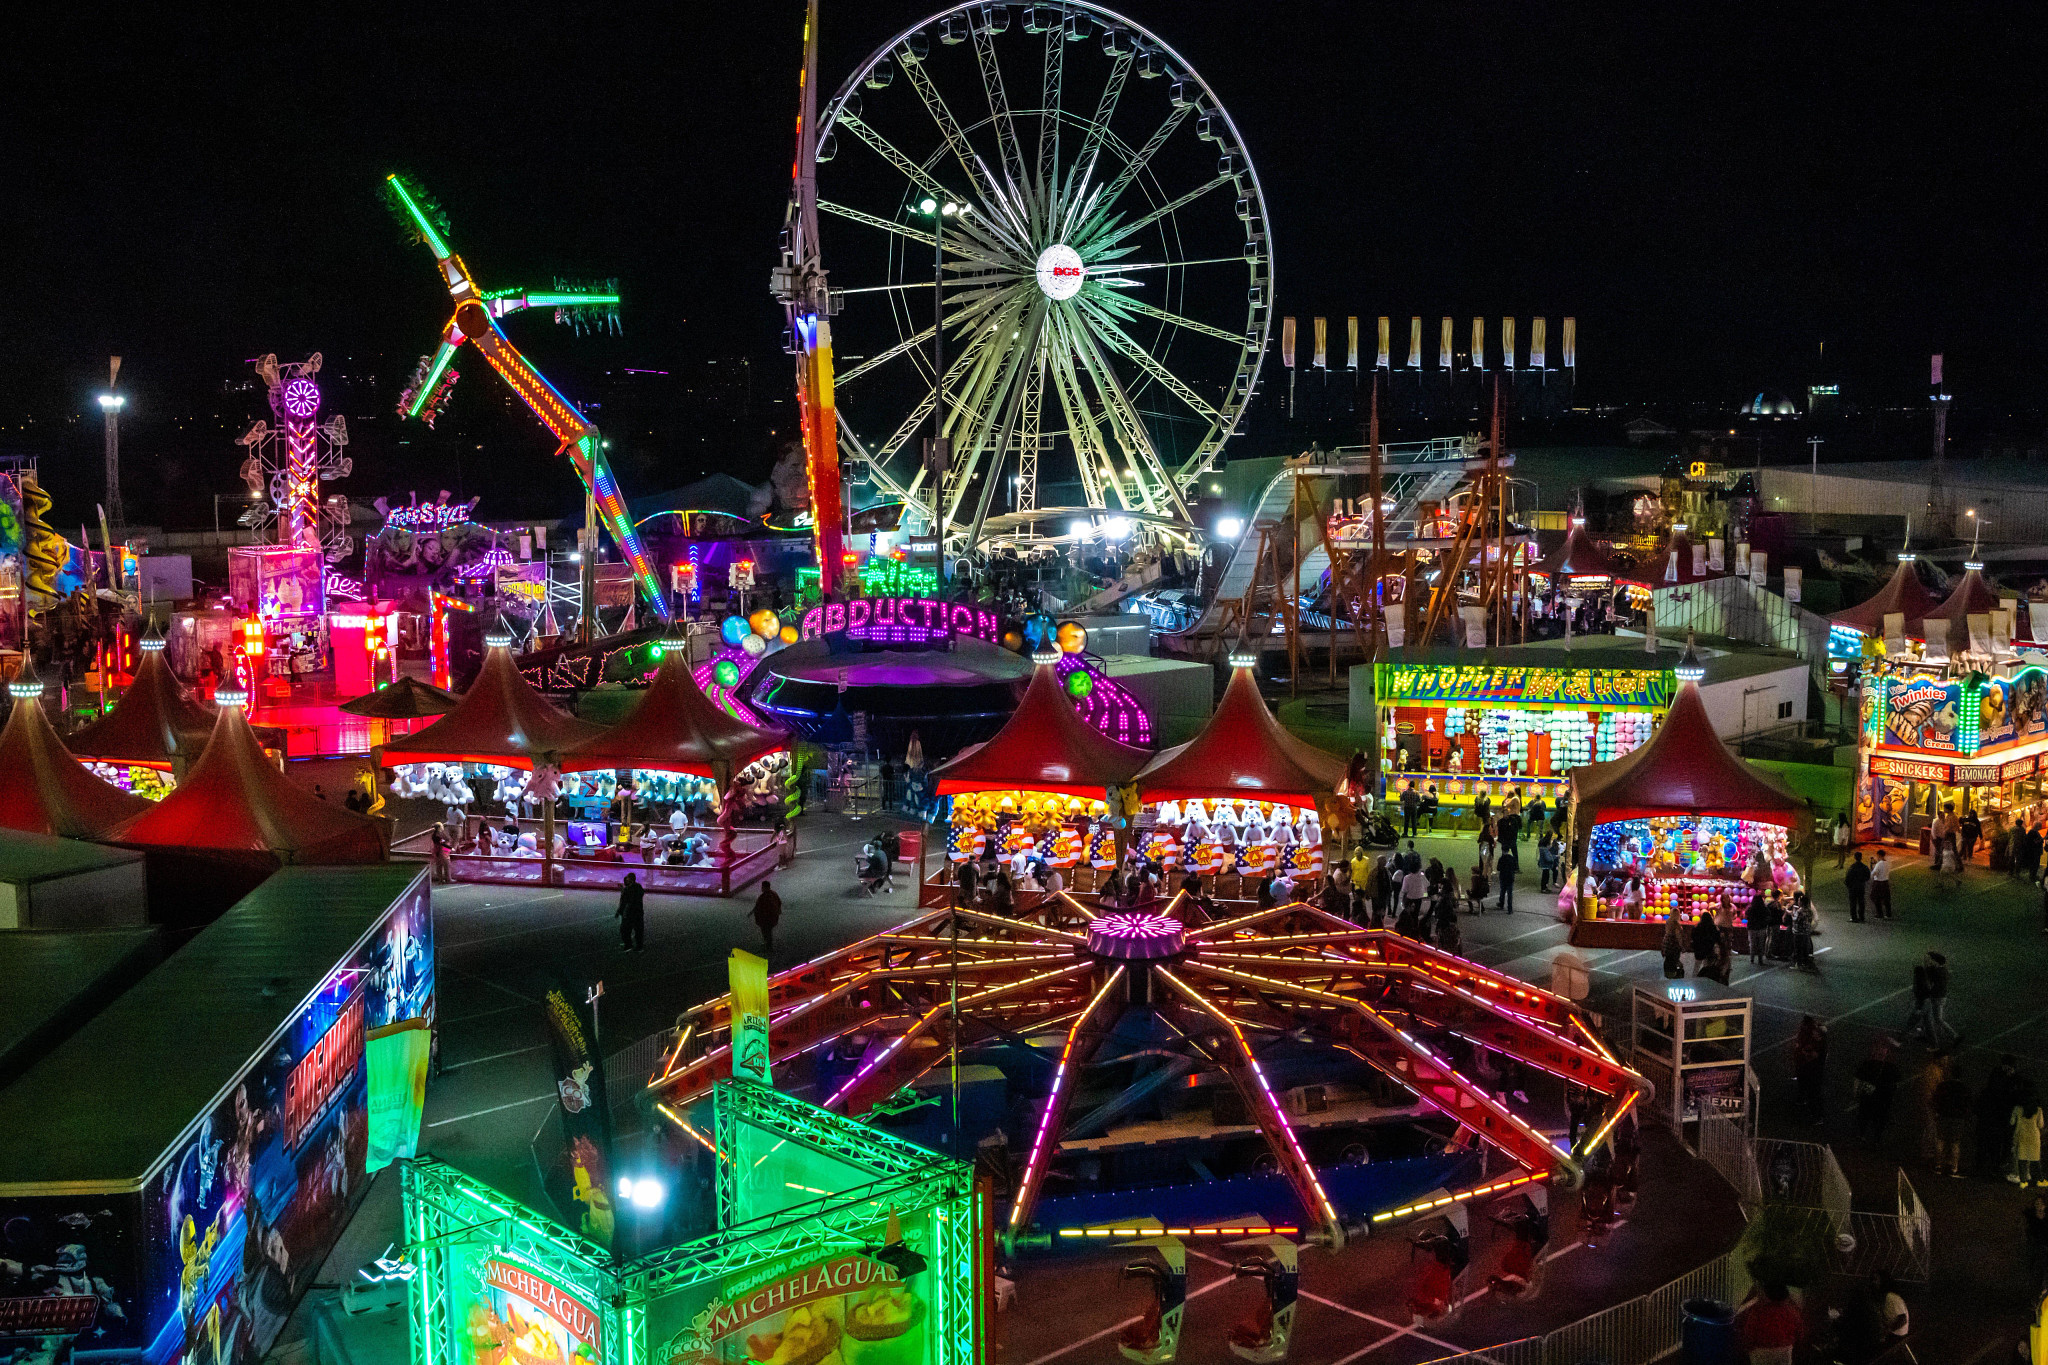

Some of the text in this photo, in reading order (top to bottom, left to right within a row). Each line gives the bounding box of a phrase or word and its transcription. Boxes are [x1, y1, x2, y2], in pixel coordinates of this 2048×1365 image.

[802, 598, 998, 644] ABDUCTION
[1392, 666, 1526, 692] WHOPPER
[1889, 686, 1947, 711] Twinkies
[1924, 738, 1955, 750] Cream
[1935, 731, 1950, 740] Ice
[1889, 761, 1944, 779] SNICKERS
[1957, 768, 1996, 781] LEMONADE
[284, 992, 366, 1152] ENDEAVOUR
[1711, 1097, 1741, 1109] EXIT
[726, 1245, 836, 1300] PREMIUM AGUAS
[1174, 1266, 1184, 1274] 13
[1286, 1265, 1297, 1273] 14
[488, 1260, 602, 1355] MICHELAGUA
[712, 1259, 900, 1336] MICHELAGUAS
